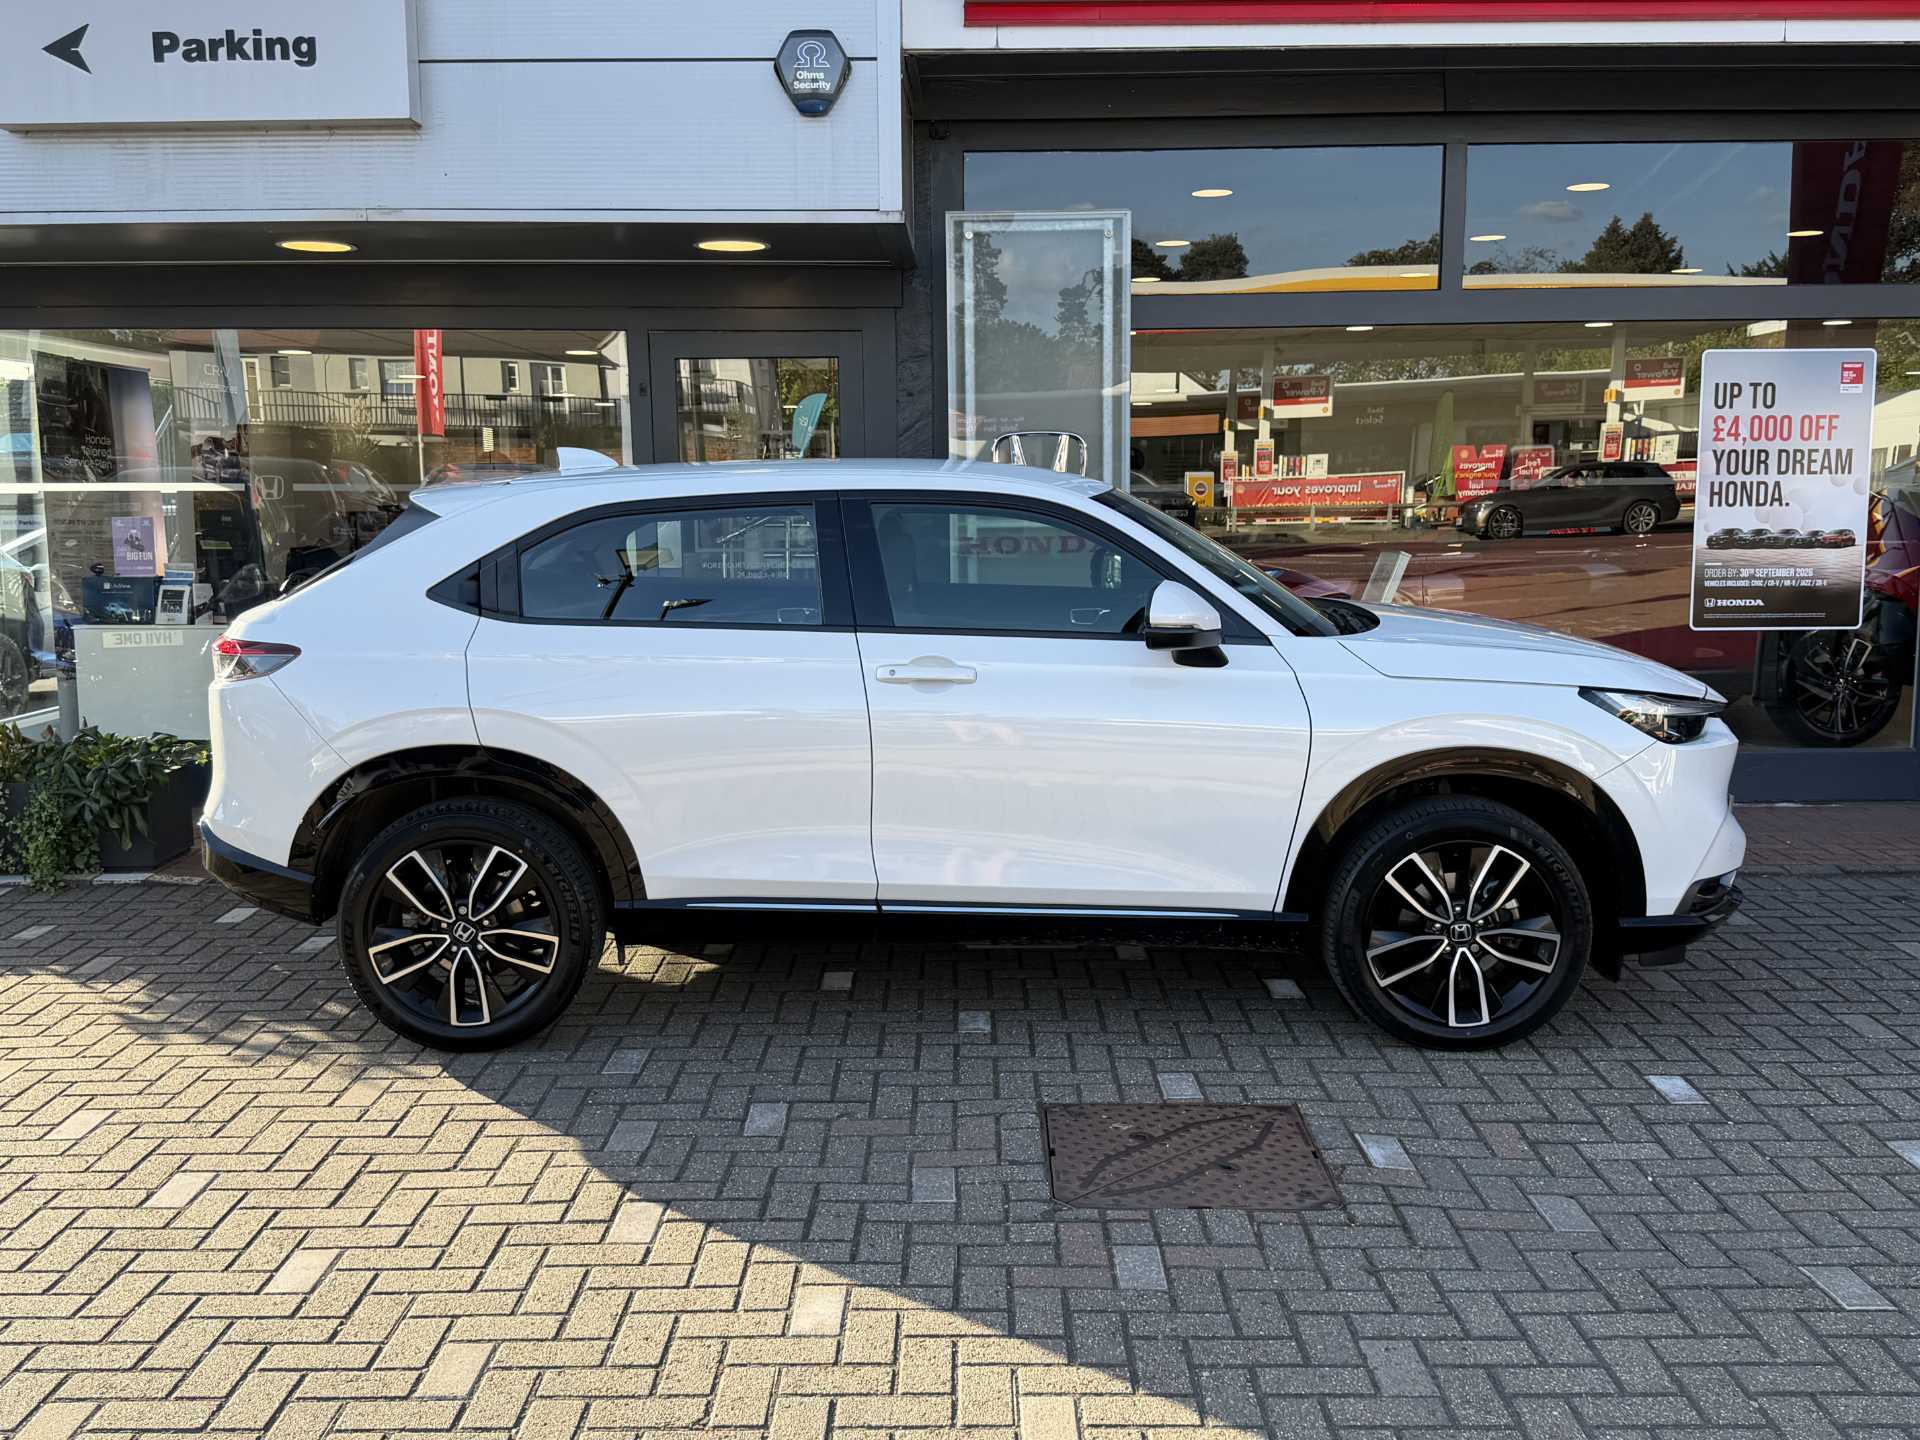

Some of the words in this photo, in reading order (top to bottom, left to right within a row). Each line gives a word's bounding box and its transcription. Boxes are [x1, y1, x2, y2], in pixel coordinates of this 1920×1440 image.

[152, 29, 317, 66] Parking
[793, 81, 831, 91] Security
[796, 71, 825, 80] Ohms
[1714, 382, 1743, 409] UP
[1749, 382, 1776, 409] TO
[1712, 414, 1792, 446] £4,000
[1800, 415, 1840, 441] OFF
[1711, 449, 1770, 475] YOUR
[1777, 448, 1854, 475] DREAM
[1709, 481, 1790, 507] HONDA.
[1704, 568, 1727, 578] ORDER
[1728, 568, 1739, 577] BY:
[1755, 567, 1795, 577] SEPTEMBER
[1717, 599, 1765, 607] HONDA
